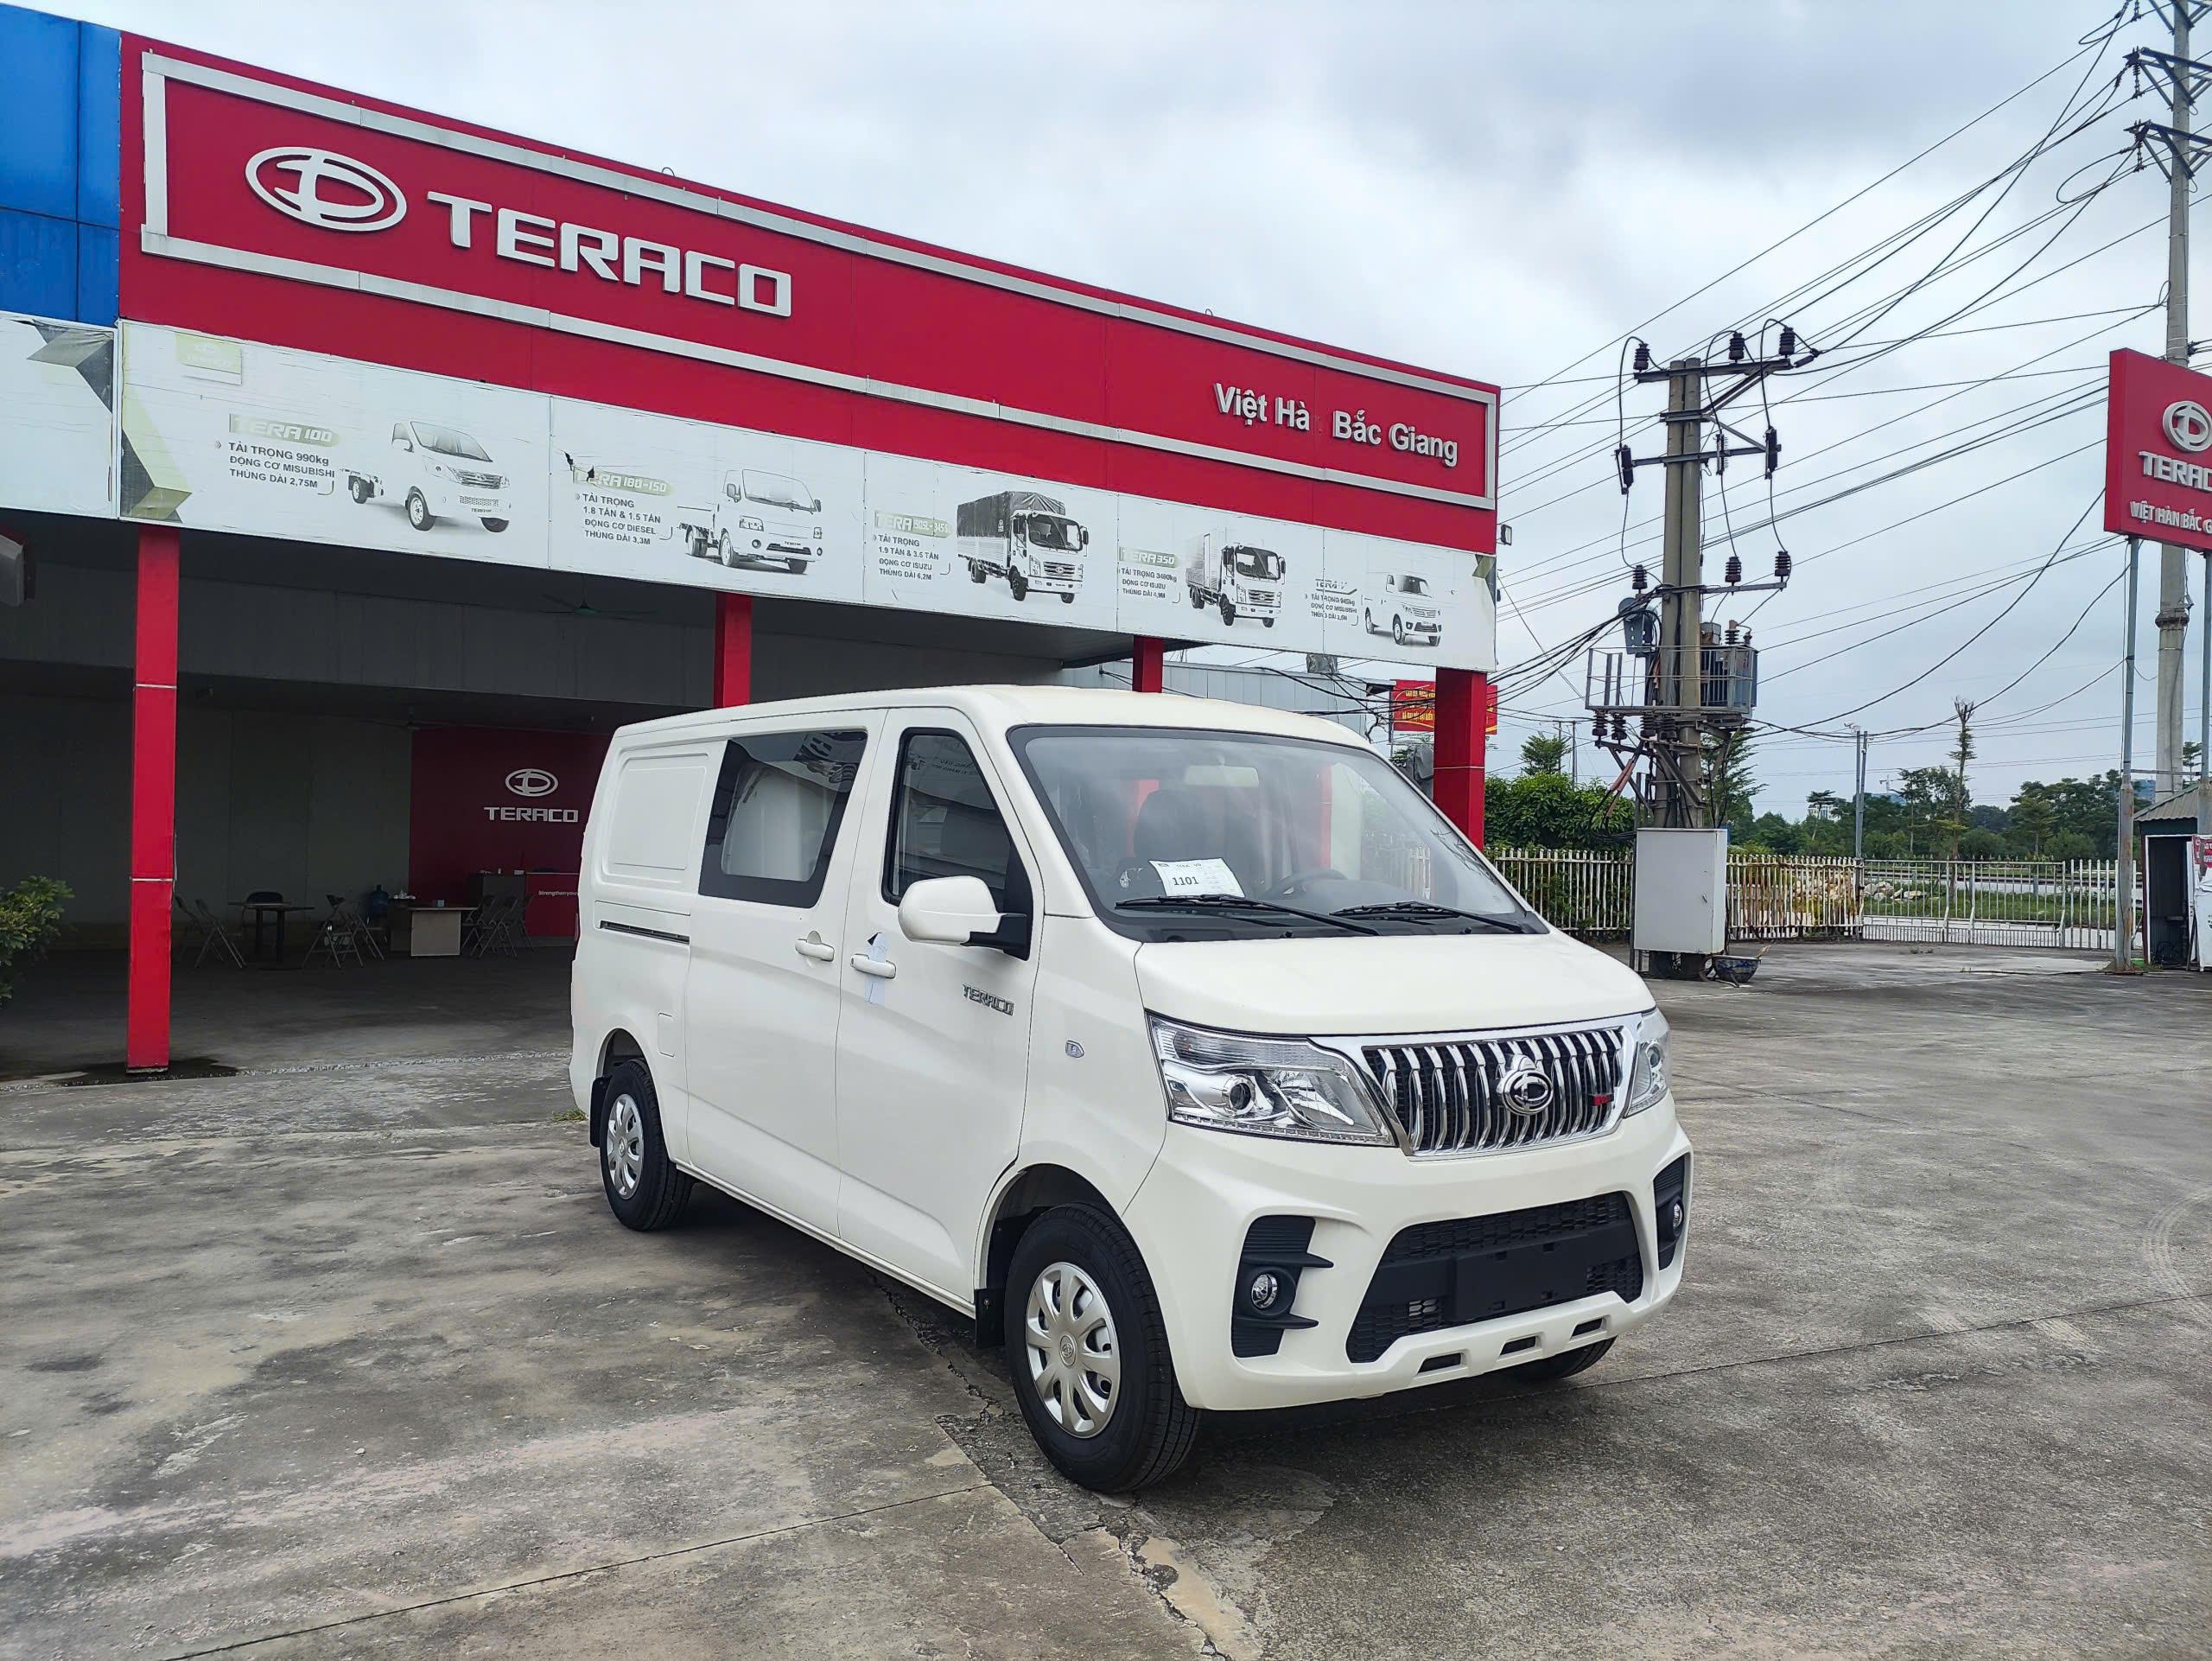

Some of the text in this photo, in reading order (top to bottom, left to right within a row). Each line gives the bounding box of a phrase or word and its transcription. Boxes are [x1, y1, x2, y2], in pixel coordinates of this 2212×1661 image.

[427, 191, 792, 318] TERACO
[1213, 382, 1459, 468] Việt Hà Bắc Giang
[304, 429, 333, 442] 100
[229, 441, 329, 467] TẢI TRỌNG 990kg
[229, 455, 335, 478] ĐỘNG CƠ MISUBISHI
[229, 468, 318, 488] THÙNG DÀI 2,75M
[623, 476, 667, 493] 180-150
[582, 493, 634, 508] TẢI TRỌNG
[583, 506, 596, 514] 1.8
[619, 510, 626, 519] &
[628, 512, 641, 521] 1.5
[875, 512, 912, 531] TERA
[2129, 500, 2155, 524] VIỆT
[2155, 506, 2180, 527] HÀN
[2180, 508, 2202, 531] BẮC
[584, 519, 657, 535] ĐỘNG CƠ DIESEL
[584, 528, 651, 545] THÙNG DÀI 3,3M
[878, 534, 920, 547] TẢI TRỌNG
[879, 568, 902, 577] THÙNG
[484, 806, 579, 823] TERACO
[1172, 875, 1199, 886] 1101
[963, 983, 1015, 1016] TERACO
